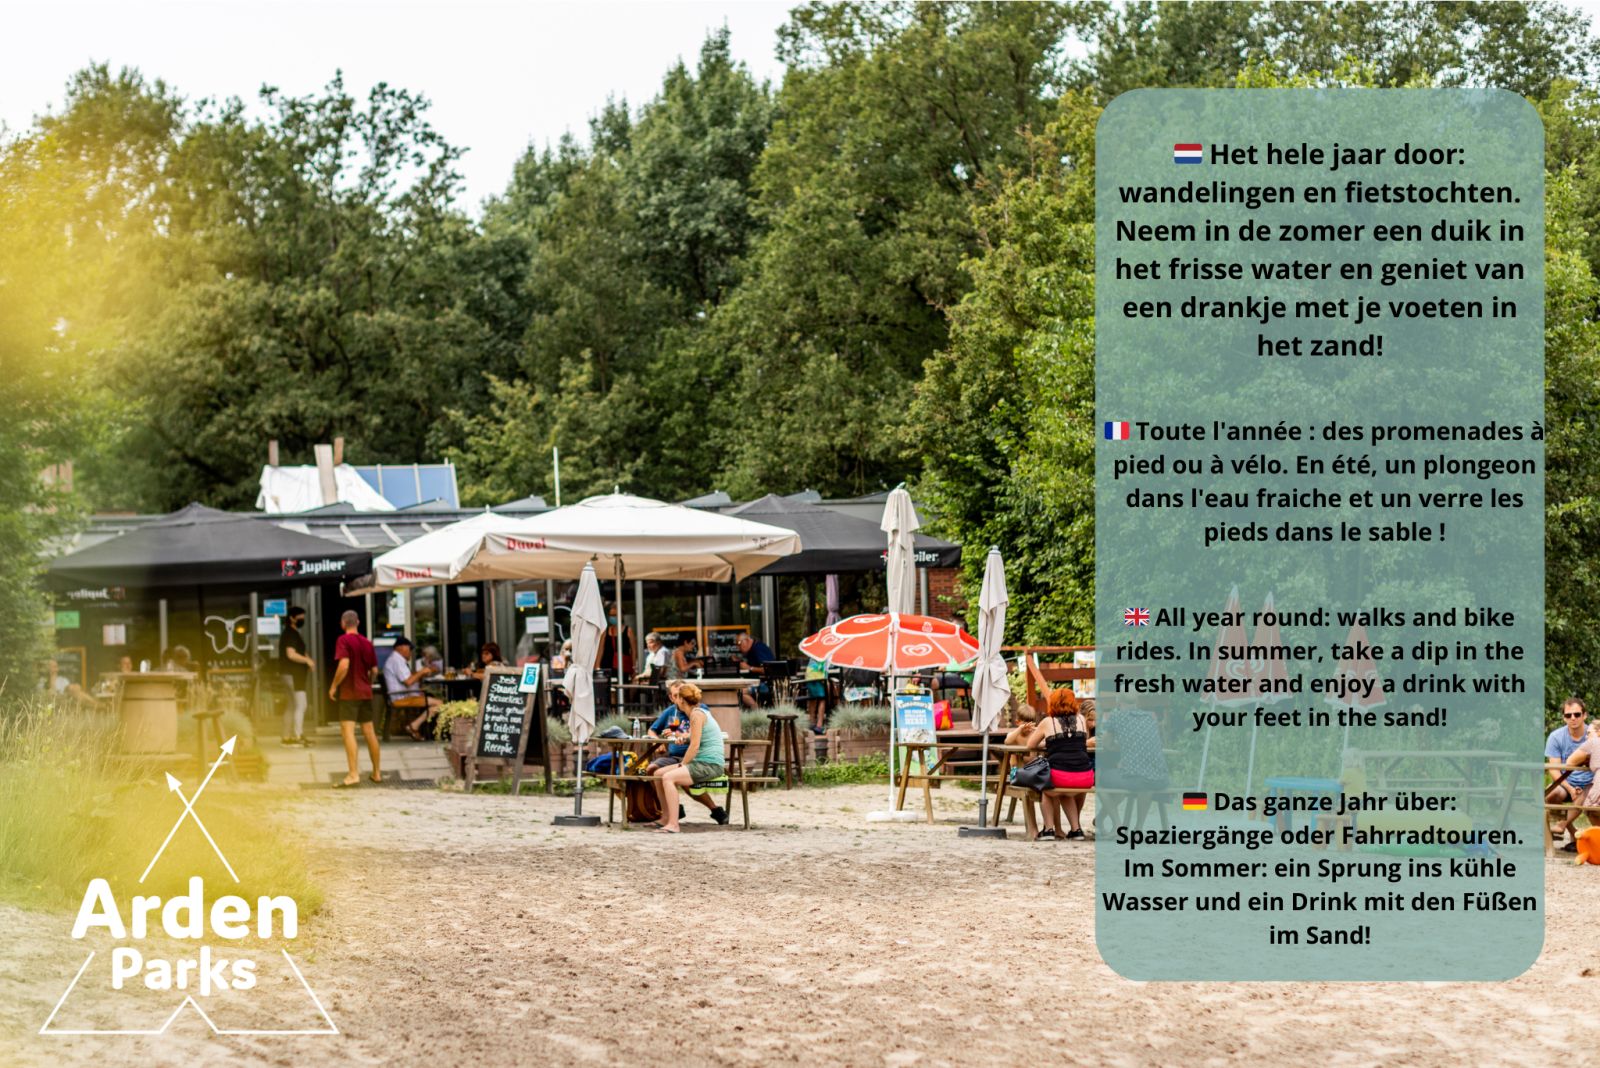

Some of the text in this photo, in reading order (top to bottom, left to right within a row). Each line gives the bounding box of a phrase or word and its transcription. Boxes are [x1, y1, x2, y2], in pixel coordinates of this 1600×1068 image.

[506, 537, 547, 550] Duvel
[298, 559, 346, 575] Jupiler
[395, 567, 432, 580] Duvel
